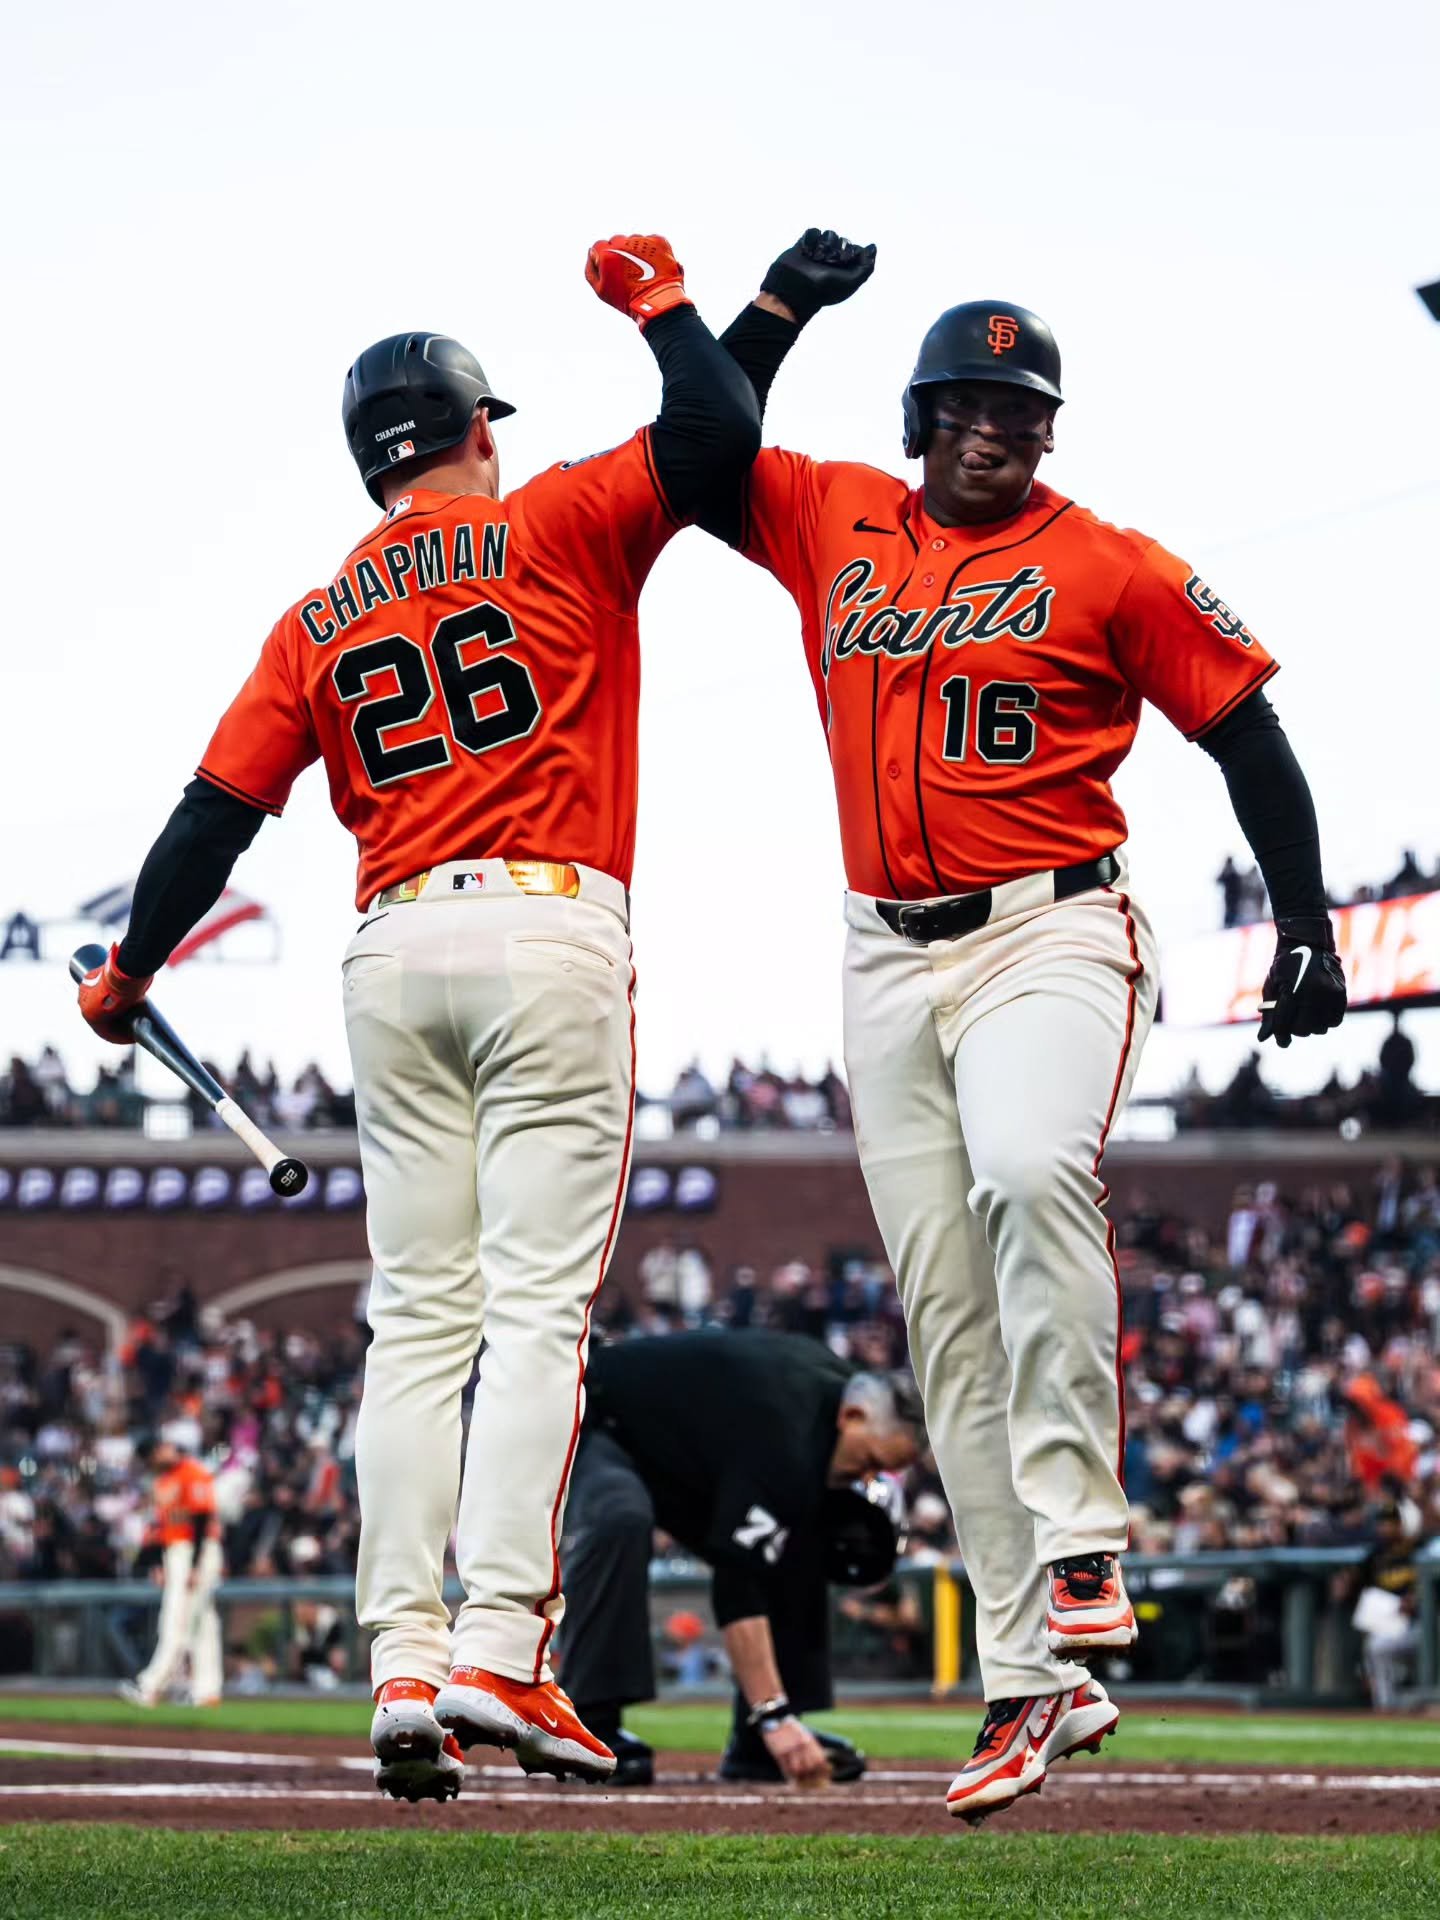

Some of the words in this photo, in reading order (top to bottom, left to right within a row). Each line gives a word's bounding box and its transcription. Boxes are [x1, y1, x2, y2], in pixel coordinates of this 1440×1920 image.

[987, 314, 1020, 355] SF
[375, 420, 416, 442] CHAPMAN
[299, 522, 509, 645] CHAPMAN
[821, 557, 1057, 680] Giants
[331, 600, 543, 789] 26
[940, 675, 1039, 766] 16
[280, 1168, 298, 1187] 26
